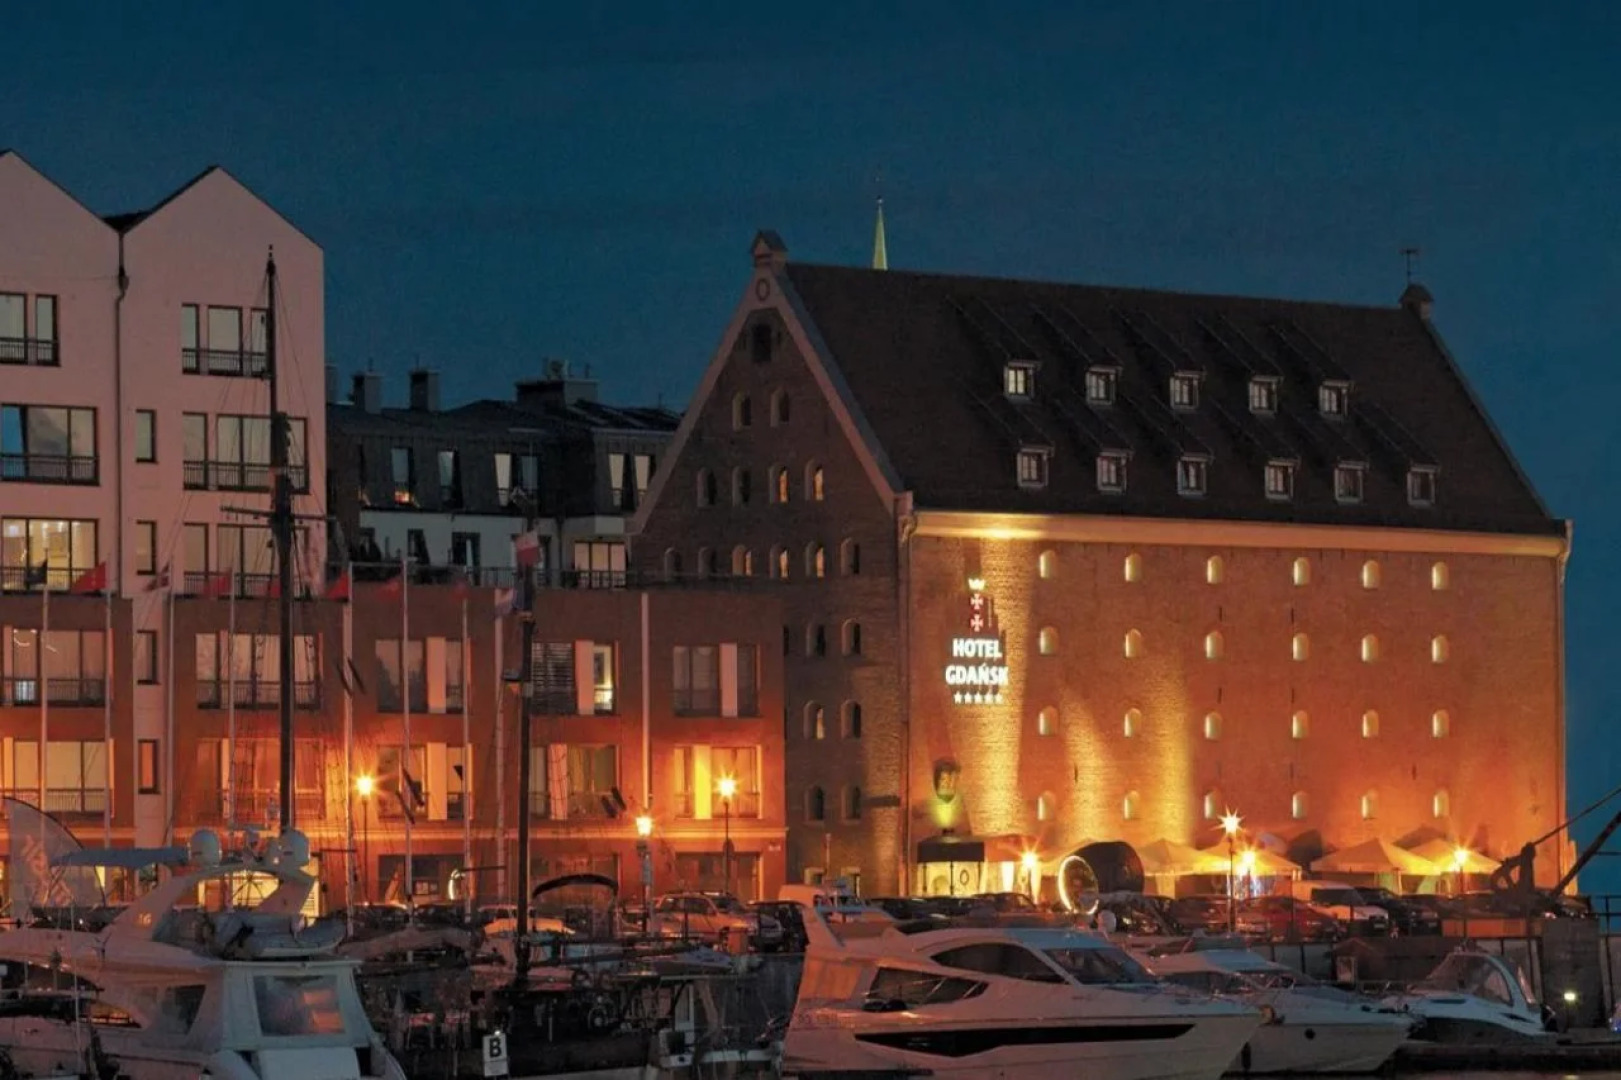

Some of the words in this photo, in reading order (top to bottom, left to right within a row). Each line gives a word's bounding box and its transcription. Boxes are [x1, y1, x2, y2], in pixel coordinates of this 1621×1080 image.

[952, 638, 1002, 658] HOTEL
[945, 662, 1008, 686] GDAŃSK
[489, 1037, 502, 1058] B
